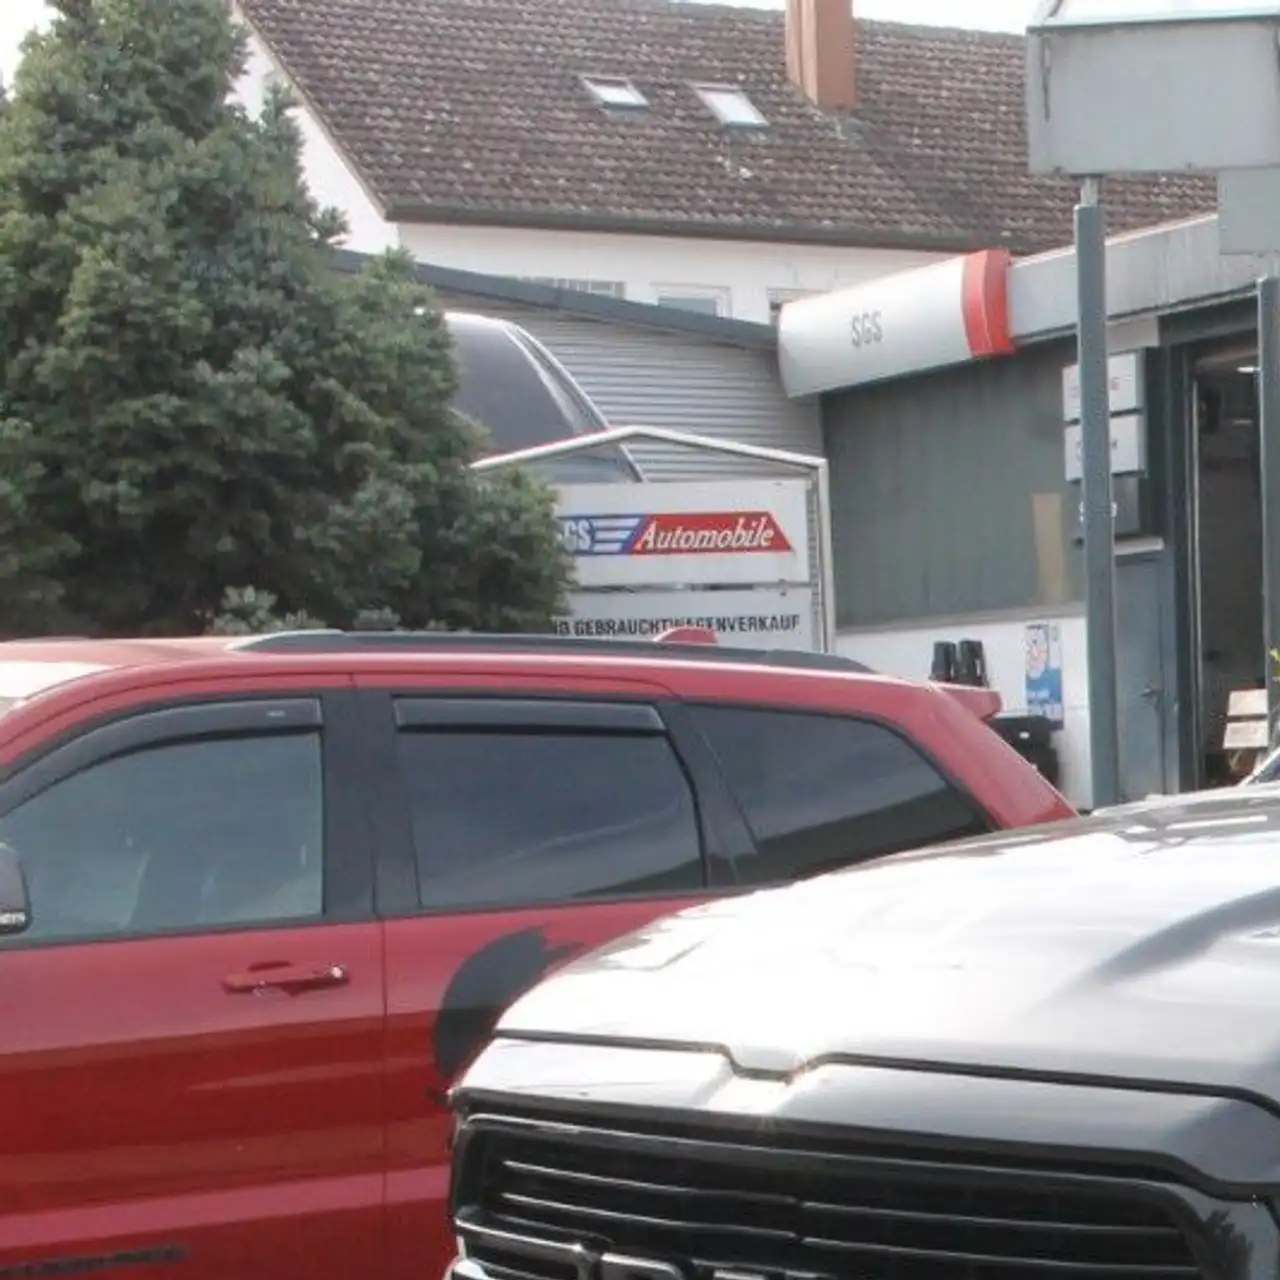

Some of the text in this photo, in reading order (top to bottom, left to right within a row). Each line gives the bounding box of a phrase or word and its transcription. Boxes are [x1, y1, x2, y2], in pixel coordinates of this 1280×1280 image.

[852, 310, 883, 348] SGS
[557, 515, 775, 552] GS Automobile
